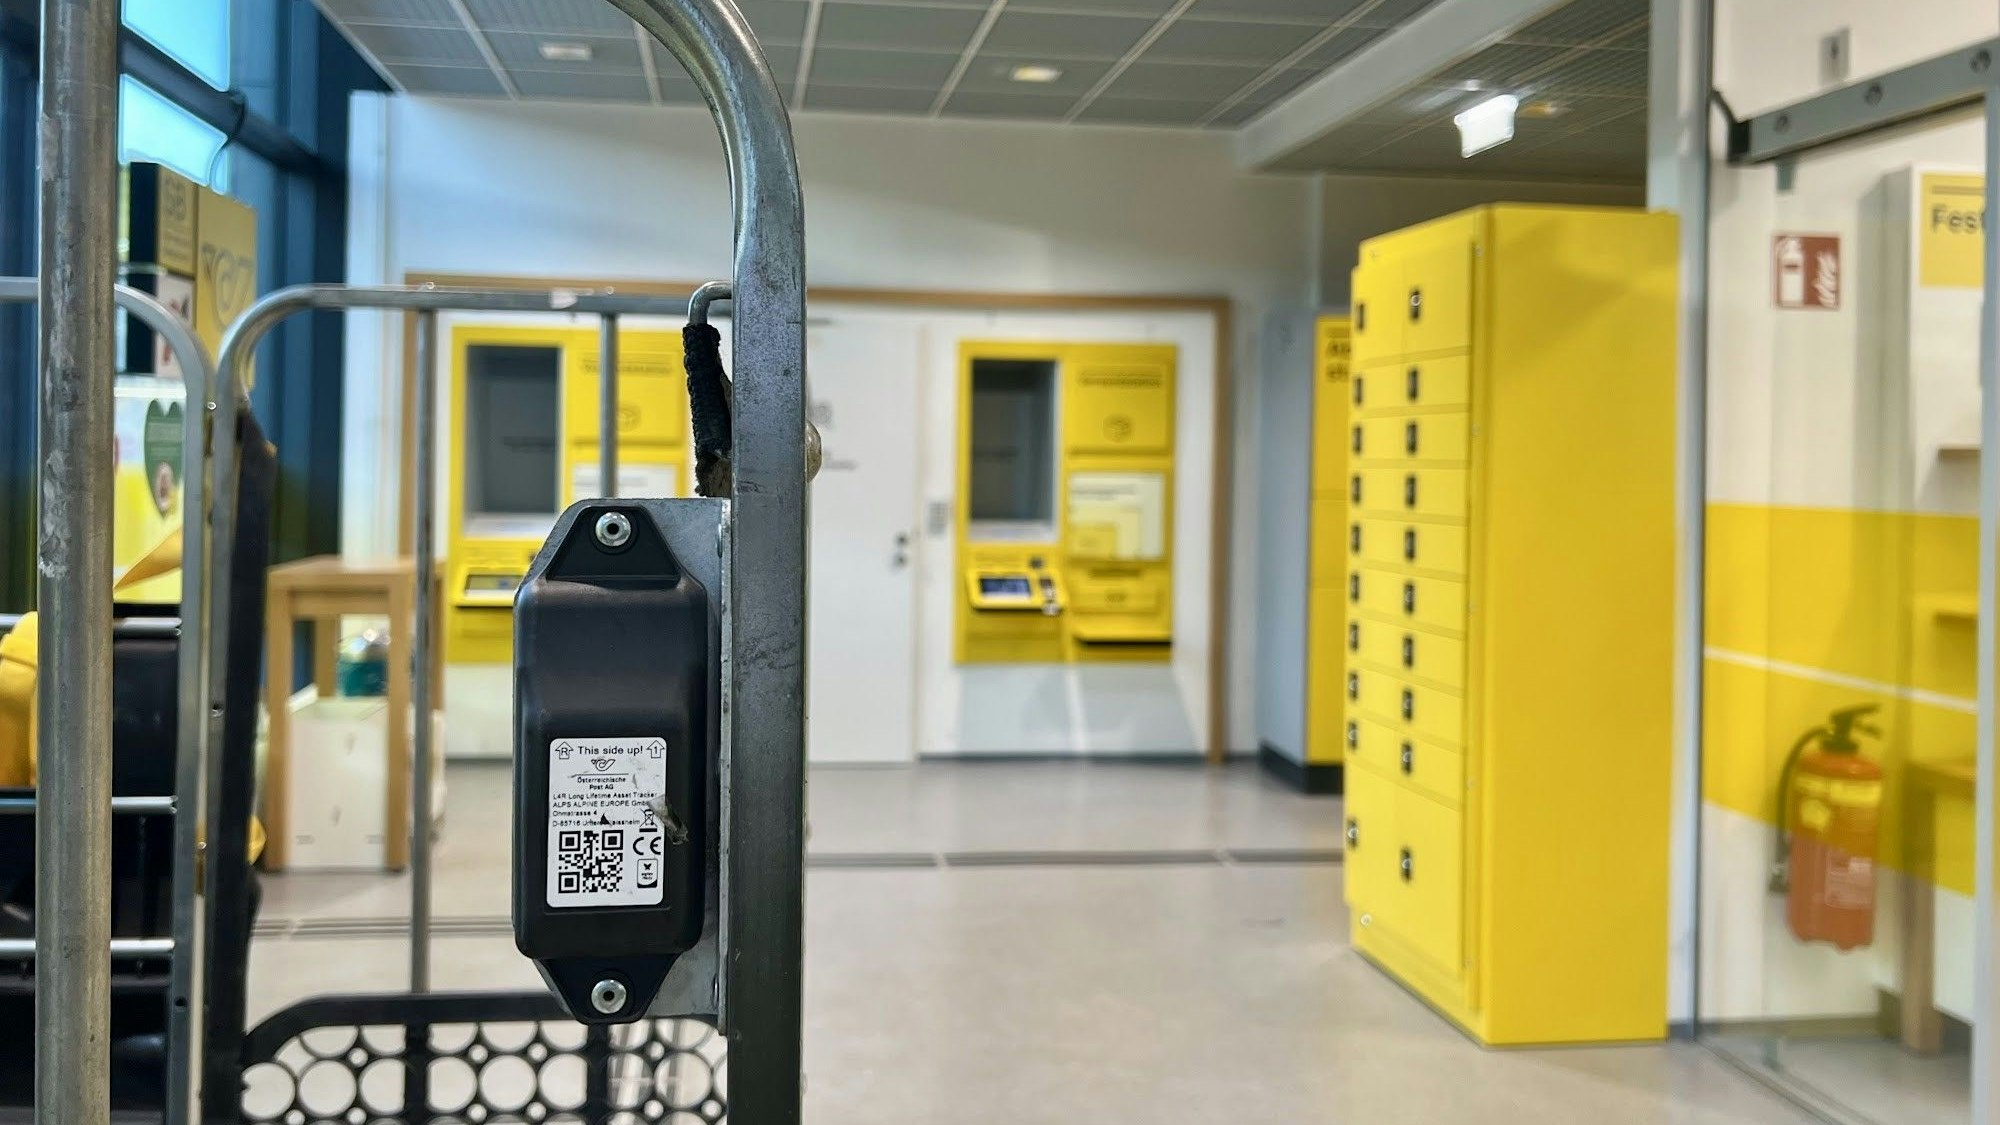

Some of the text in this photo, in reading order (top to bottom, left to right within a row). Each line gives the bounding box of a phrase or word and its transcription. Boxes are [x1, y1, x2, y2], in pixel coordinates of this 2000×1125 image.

[577, 745, 643, 757] This side up!
[569, 793, 585, 801] Long
[573, 800, 598, 808] ALPINE
[632, 836, 662, 856] CE
